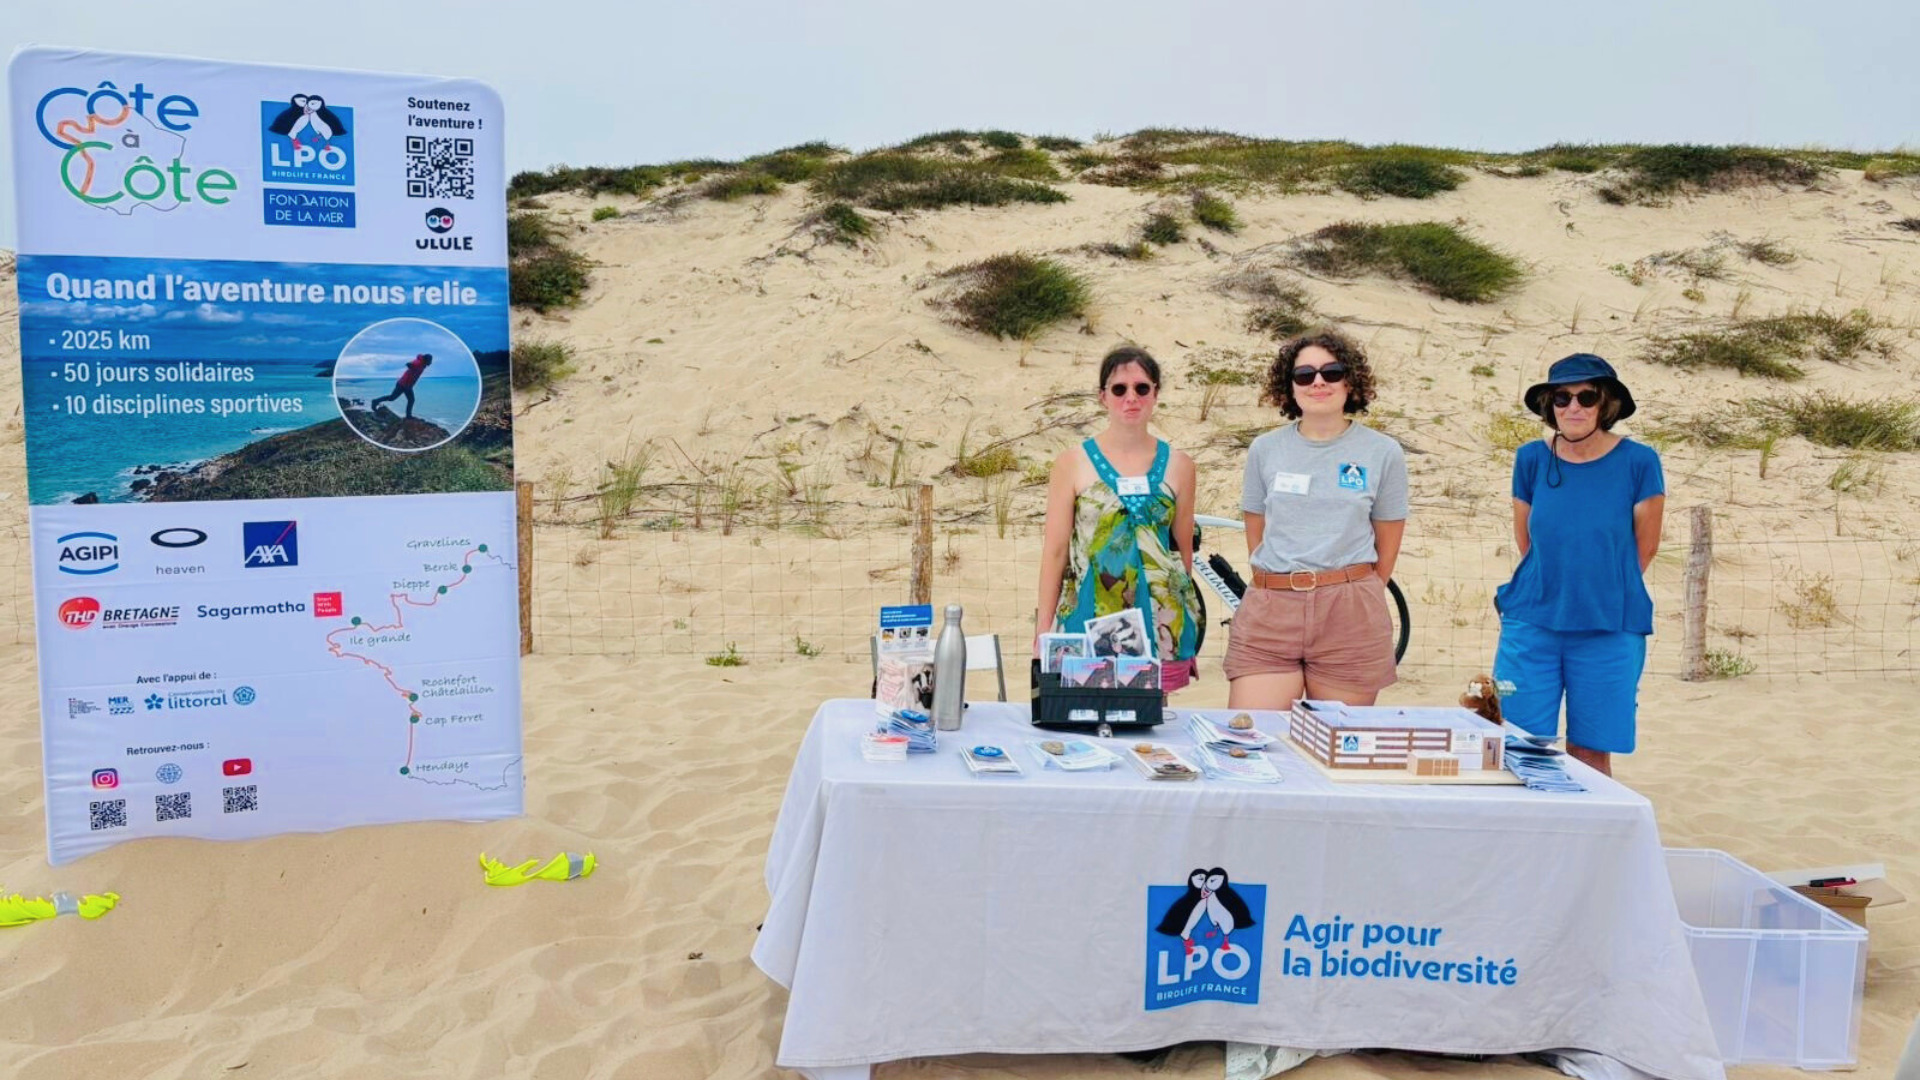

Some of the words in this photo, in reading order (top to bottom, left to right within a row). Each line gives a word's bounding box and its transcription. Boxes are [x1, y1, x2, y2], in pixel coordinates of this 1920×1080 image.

[407, 97, 471, 112] Soutenez
[36, 80, 199, 150] Côte
[408, 114, 475, 130] l'aventure
[121, 128, 140, 149] à
[271, 142, 347, 171] LPO
[60, 141, 238, 205] Côte
[271, 170, 310, 179] BIRDLIFE
[312, 172, 346, 181] FRANCE
[269, 193, 350, 208] FONDATION
[275, 209, 293, 221] DE
[297, 210, 313, 222] LA
[319, 211, 344, 223] MER
[415, 236, 473, 250] ULULE
[46, 272, 156, 302] Quand
[164, 274, 325, 303] l'aventure
[333, 283, 406, 305] nous
[413, 280, 478, 305] relie
[61, 329, 113, 350] 2025
[119, 329, 150, 350] km
[64, 362, 90, 382] 50
[96, 362, 149, 387] jours
[154, 362, 255, 382] solidaires
[65, 395, 87, 415] 10
[92, 394, 206, 418] disciplines
[211, 393, 303, 418] sportives
[1341, 475, 1364, 486] LPO
[406, 537, 471, 549] Gravelines
[59, 545, 119, 562] AGIPI
[245, 544, 289, 564] AXA
[156, 564, 205, 575] heaven
[423, 563, 459, 573] Berck
[393, 579, 431, 590] Dieppe
[65, 610, 99, 623] THD
[103, 606, 180, 621] BRETAGNE
[197, 600, 306, 620] Sagarmatha
[367, 633, 412, 647] grande
[136, 675, 161, 684] Avec
[198, 671, 211, 681] de
[422, 674, 478, 687] Rochefort
[108, 696, 129, 705] MER
[168, 692, 228, 709] littoral
[425, 716, 448, 727] Cap
[451, 713, 483, 724] Ferret
[126, 742, 205, 756] Retrouvez-nous
[416, 760, 470, 773] Hendaye
[1284, 914, 1354, 949] Agir
[1362, 923, 1442, 949] pour
[1157, 943, 1251, 985] LPO
[1283, 948, 1312, 977] la
[1321, 949, 1518, 985] biodiversité
[1156, 984, 1199, 1001] BIRDLIFE
[1201, 982, 1247, 996] FRANCE
